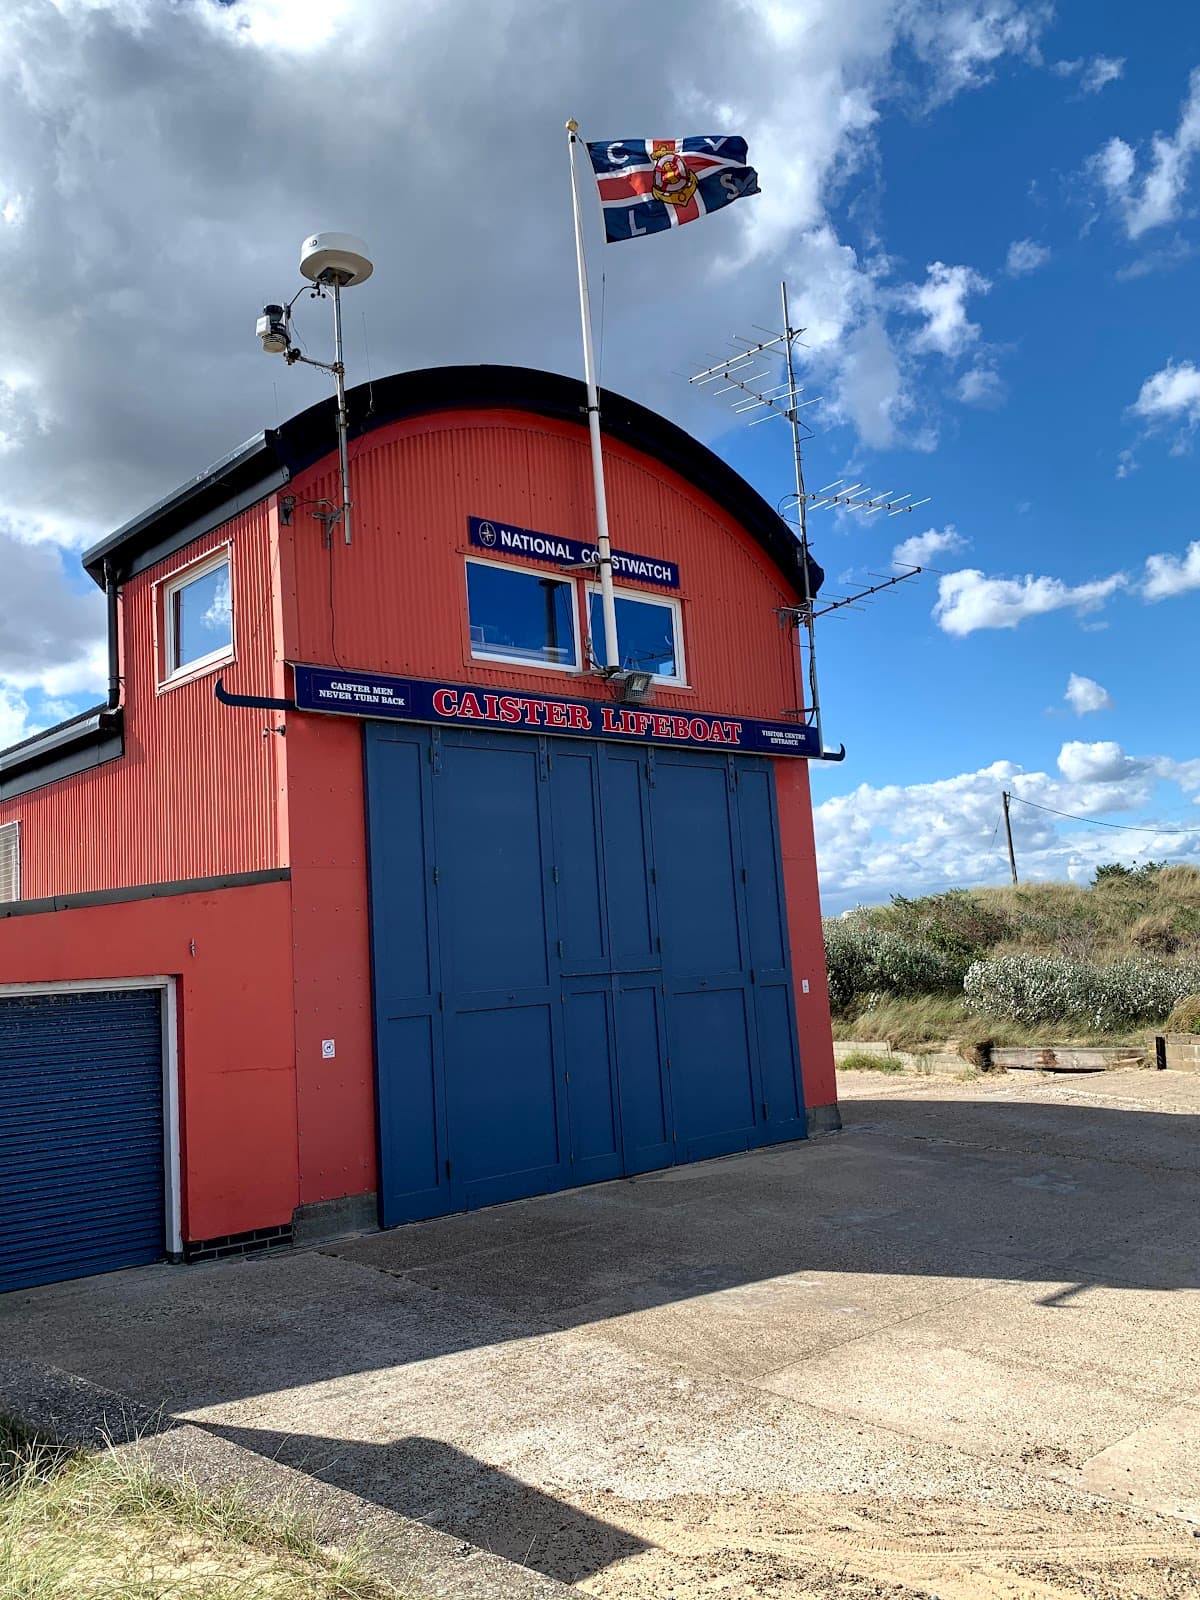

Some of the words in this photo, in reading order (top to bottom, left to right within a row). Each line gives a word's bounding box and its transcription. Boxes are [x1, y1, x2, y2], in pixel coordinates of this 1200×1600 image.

[607, 142, 630, 165] C
[703, 137, 728, 152] V
[719, 173, 739, 200] S
[628, 210, 647, 236] L
[500, 530, 575, 560] NATIONAL
[581, 549, 672, 581] COSTWATCH
[318, 689, 352, 701] NEVER
[353, 693, 379, 703] TURN
[381, 695, 406, 706] BACK
[330, 681, 371, 694] CAISTER
[372, 686, 394, 696] MEN
[432, 689, 592, 730] CAISTER
[601, 708, 742, 745] LIFEBOAT
[761, 729, 784, 738] VISITOR
[770, 737, 799, 746] ENTRANCE
